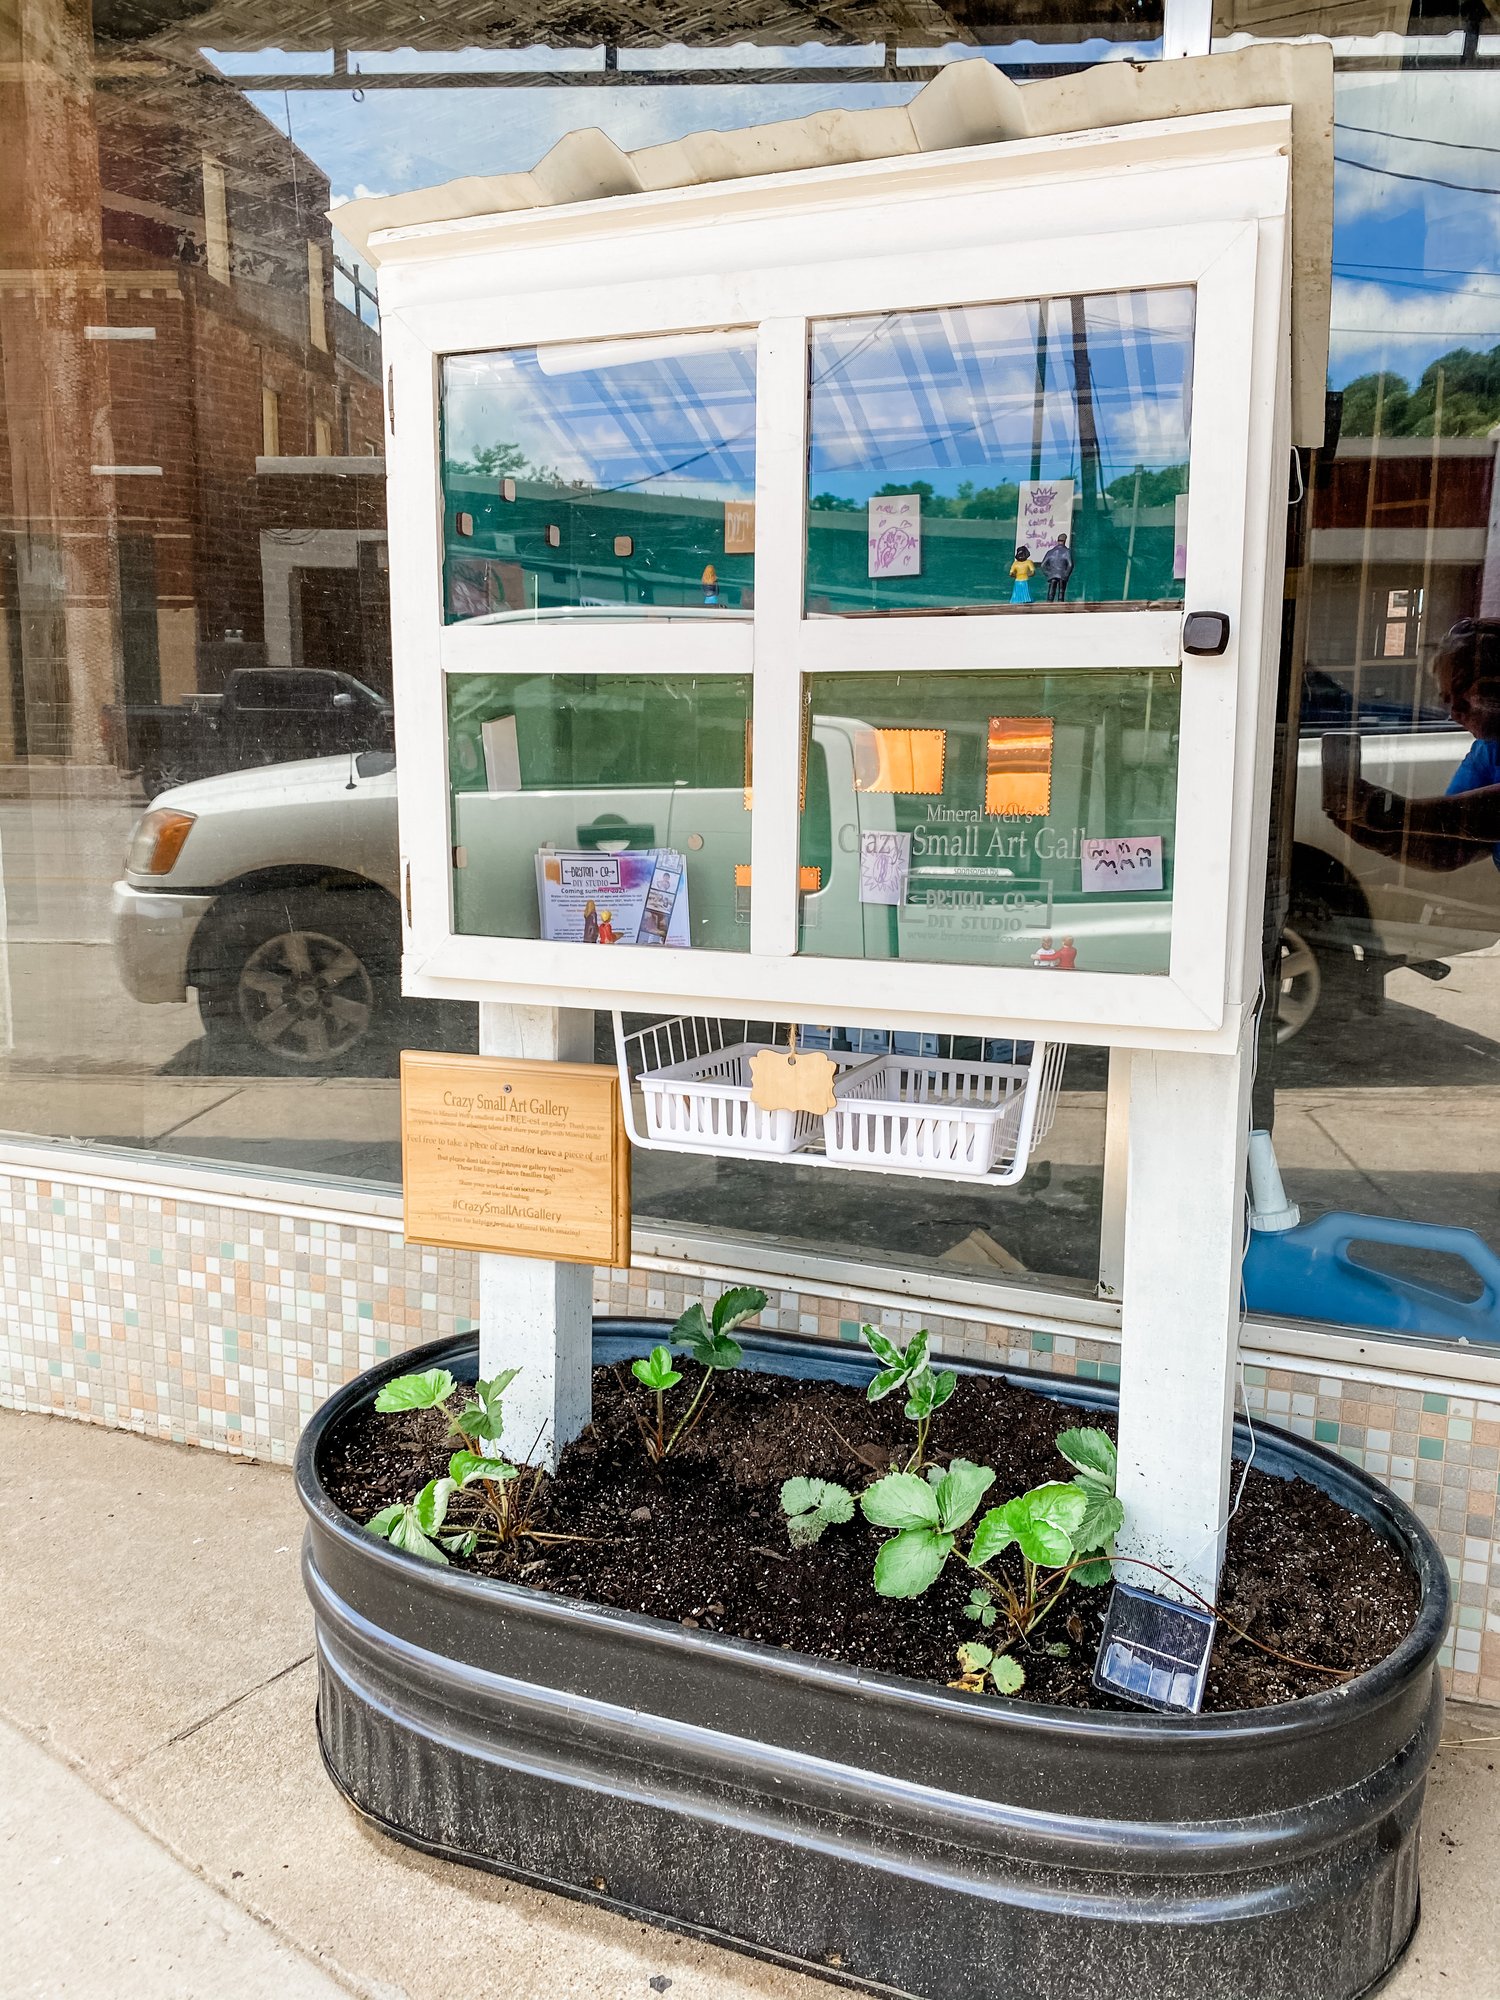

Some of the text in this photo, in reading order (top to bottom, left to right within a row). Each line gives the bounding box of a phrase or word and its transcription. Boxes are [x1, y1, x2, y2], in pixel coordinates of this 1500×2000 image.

[926, 803, 1033, 824] Mineral Well's
[838, 823, 1128, 870] Crazy Small Art Gallery
[953, 867, 999, 877] sponsored by
[927, 914, 1022, 931] DIY STUDIO
[443, 1090, 570, 1122] Crazy Small Art Gallery
[407, 1134, 421, 1143] Feel
[423, 1135, 436, 1144] free
[447, 1138, 462, 1147] take
[470, 1141, 488, 1150] piece
[490, 1142, 498, 1150] of
[499, 1144, 509, 1152] art
[511, 1145, 536, 1154] and/or
[537, 1147, 556, 1156] leave
[564, 1151, 584, 1160] piece
[585, 1152, 593, 1161] of
[487, 1167, 505, 1175] people
[520, 1170, 542, 1178] families
[528, 1163, 547, 1172] gallery
[452, 1199, 562, 1223] #CrazySmallArtGallery
[517, 1223, 538, 1232] Mineral
[540, 1225, 554, 1234] Wells
